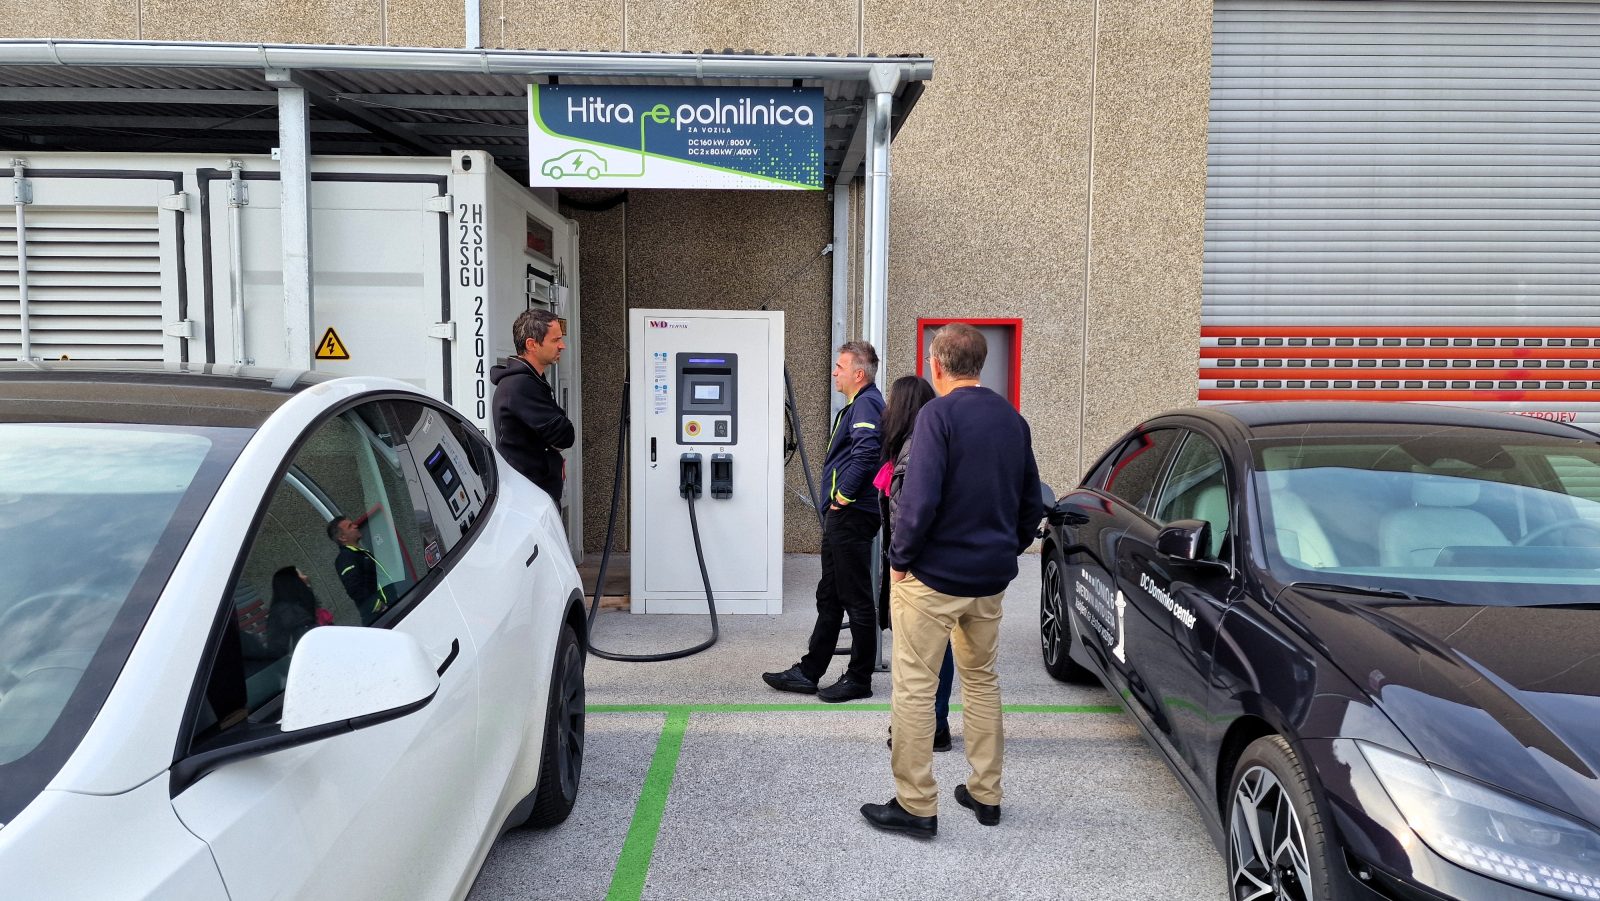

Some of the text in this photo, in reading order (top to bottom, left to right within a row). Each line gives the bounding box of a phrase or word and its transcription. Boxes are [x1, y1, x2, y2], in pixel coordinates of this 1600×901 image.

[567, 96, 814, 131] Hitra e.polnilnica
[472, 203, 484, 287] HSCU
[474, 296, 486, 420] 220400
[1140, 572, 1196, 630] DC Dominko center
